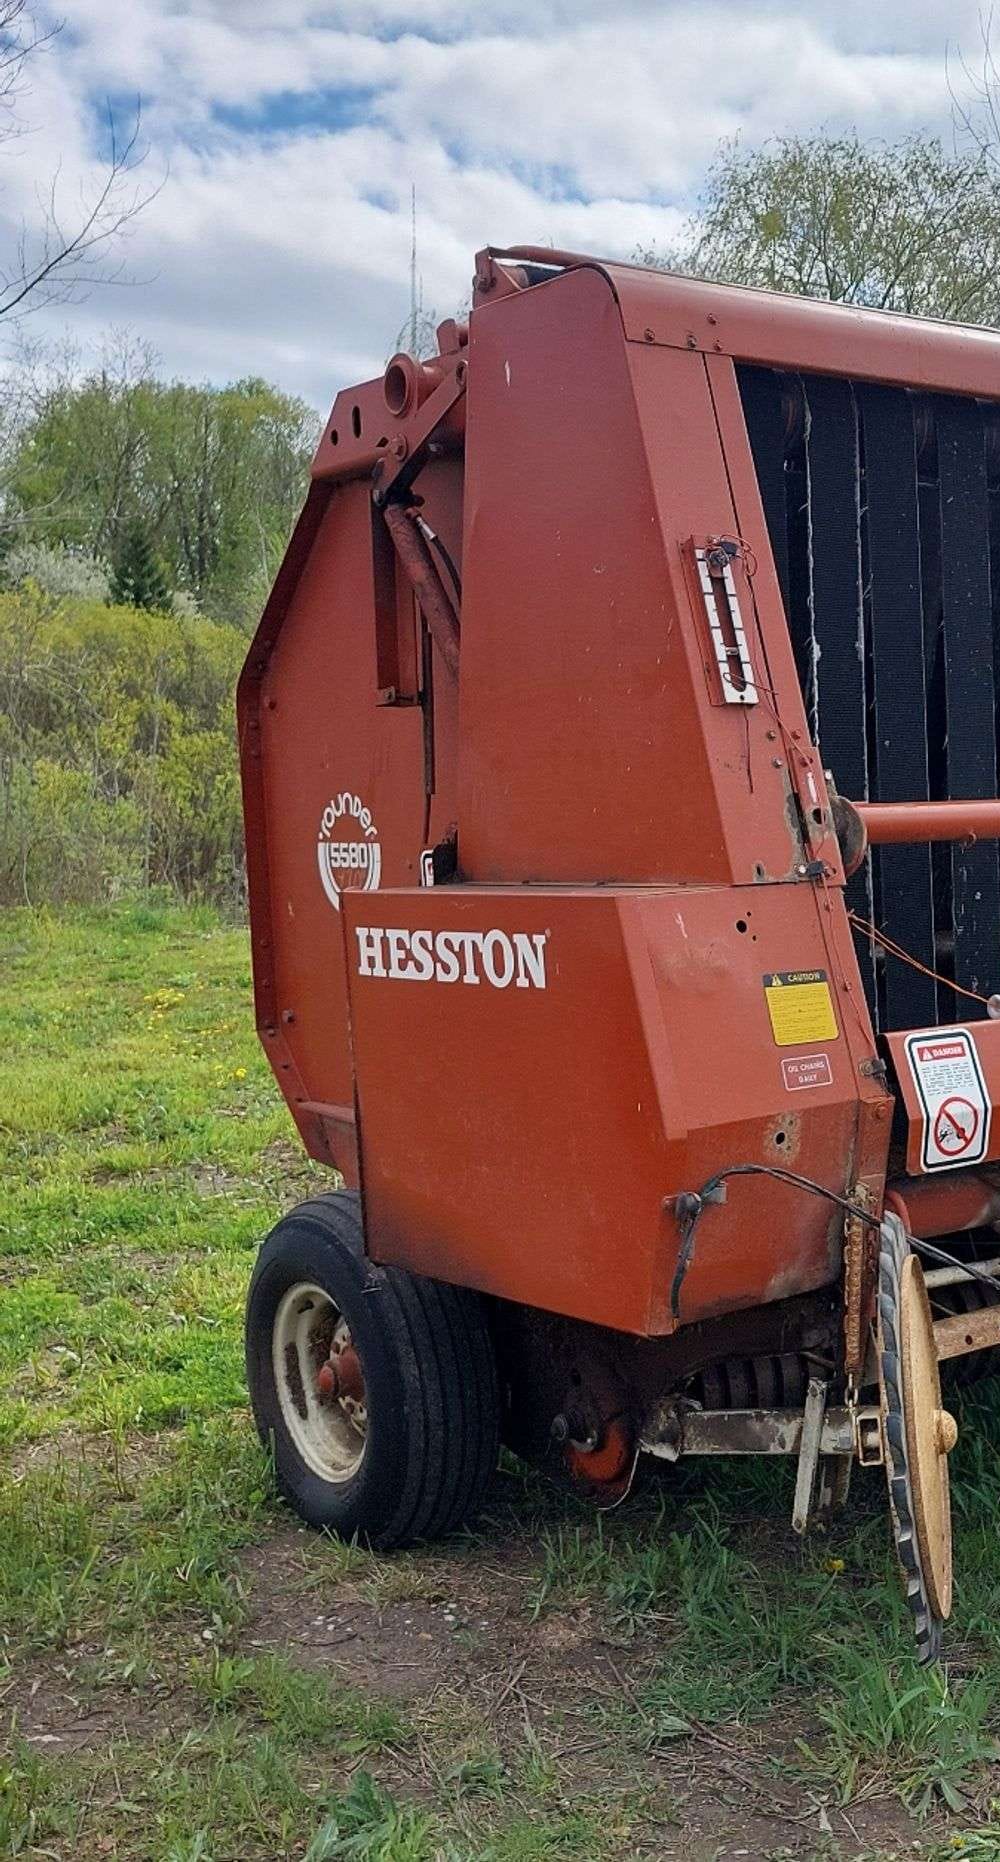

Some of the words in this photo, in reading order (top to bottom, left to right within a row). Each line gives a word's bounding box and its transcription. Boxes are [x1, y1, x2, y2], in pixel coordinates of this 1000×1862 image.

[331, 842, 368, 868] 5580
[355, 926, 547, 988] HESSTON
[787, 973, 821, 983] CAUTION
[931, 1046, 963, 1058] DANGER
